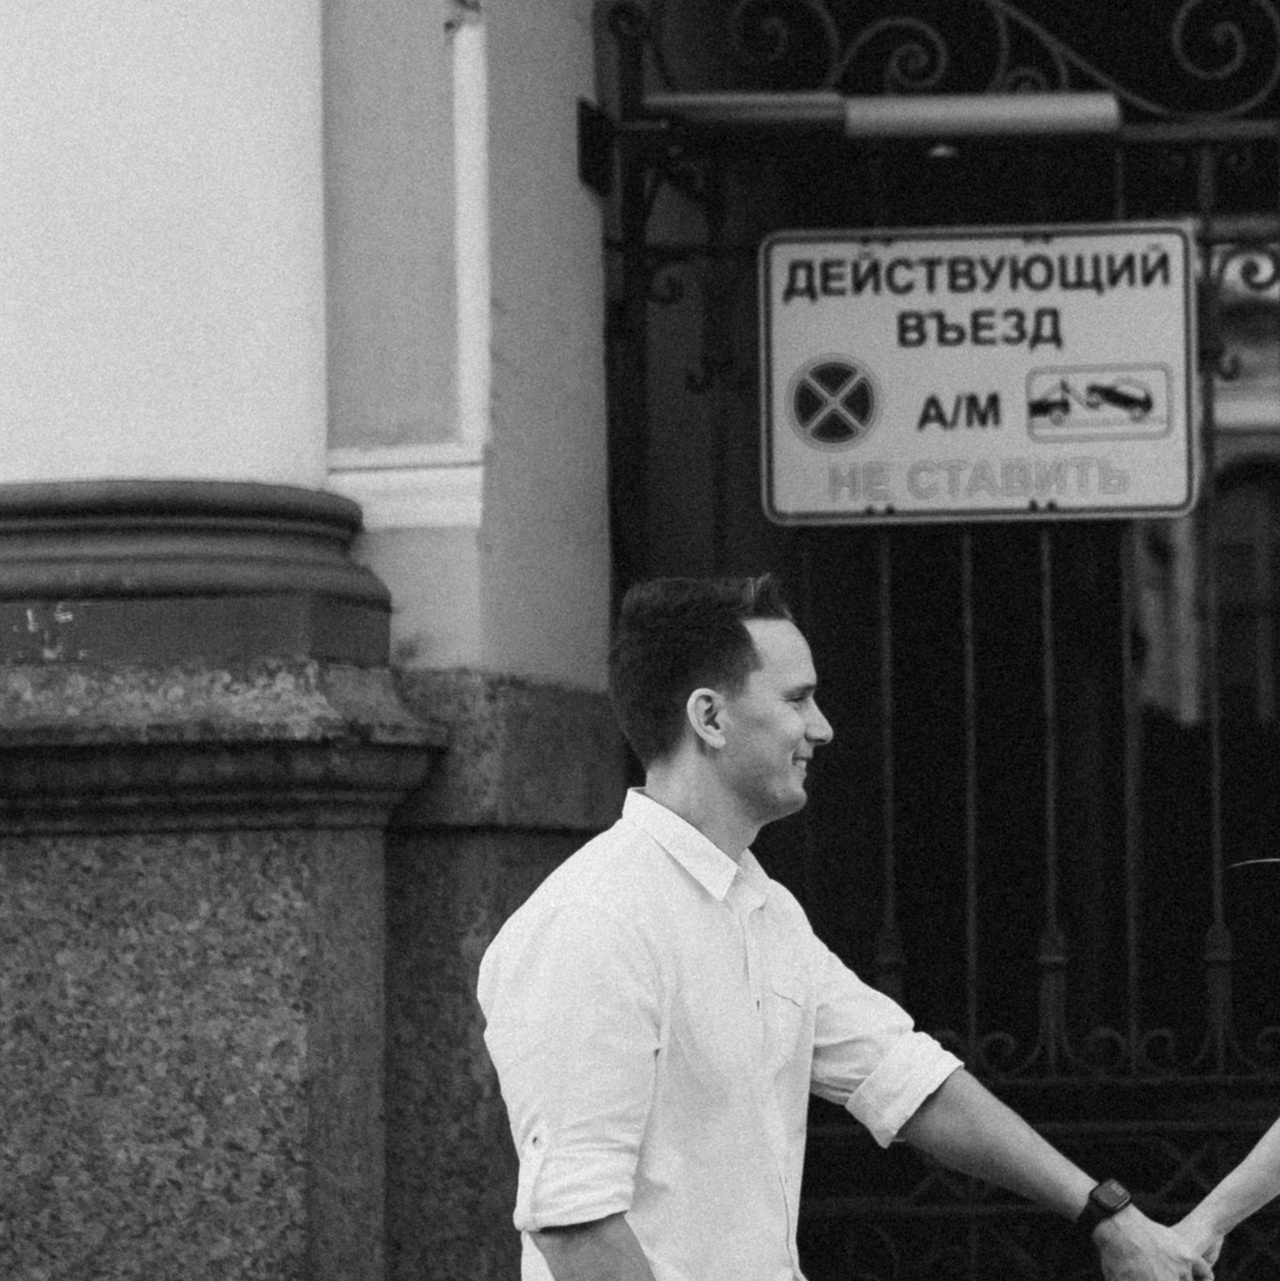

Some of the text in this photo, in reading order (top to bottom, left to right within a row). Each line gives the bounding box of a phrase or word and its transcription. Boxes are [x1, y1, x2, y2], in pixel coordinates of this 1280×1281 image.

[782, 242, 1171, 303] ДЕЙСТВУЮЩИЙ
[897, 307, 1063, 351] ВЪЕЗД
[917, 391, 1001, 432] А/М
[827, 456, 1132, 502] НЕ СТАВИТЬ
